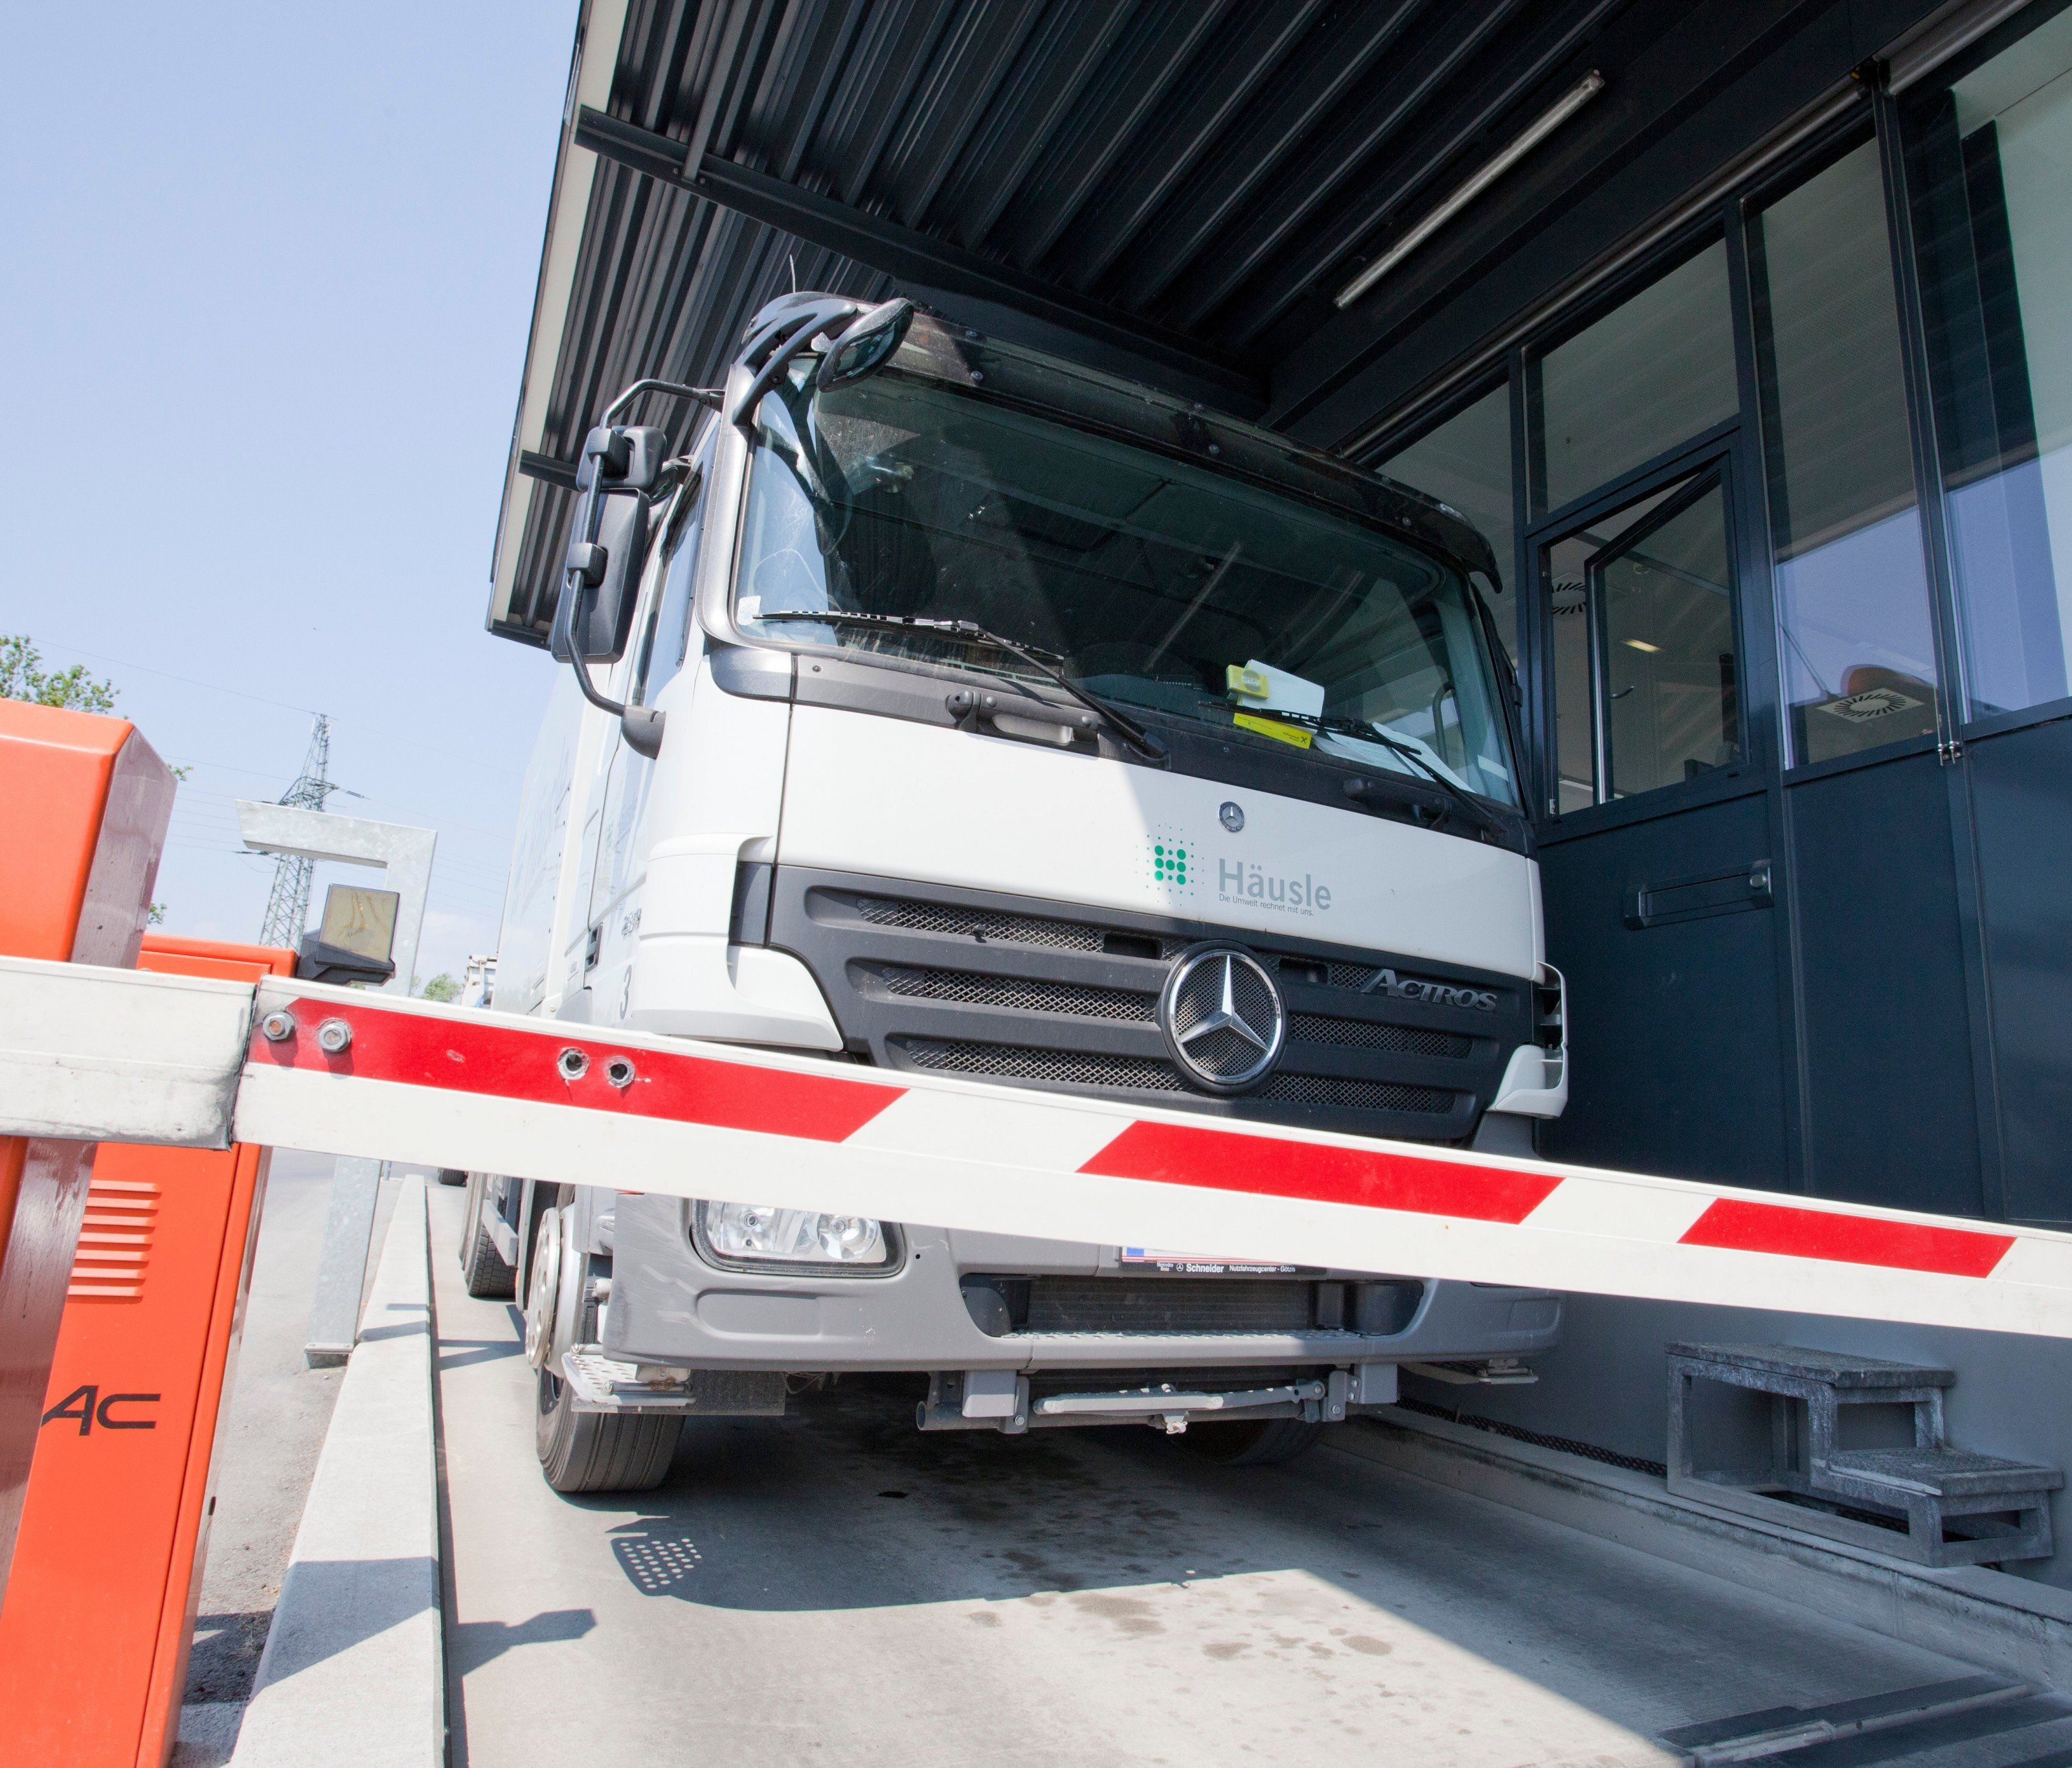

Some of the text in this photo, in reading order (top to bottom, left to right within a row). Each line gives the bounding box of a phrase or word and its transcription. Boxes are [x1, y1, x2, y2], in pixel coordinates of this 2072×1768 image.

[1219, 858, 1331, 910] Häusle
[1219, 894, 1230, 902] Die
[1233, 896, 1258, 907] Umwelt
[1260, 901, 1285, 912] rechnet
[1186, 1263, 1224, 1273] Schneider
[1229, 1265, 1277, 1274] Nutzfahrzeugcenter
